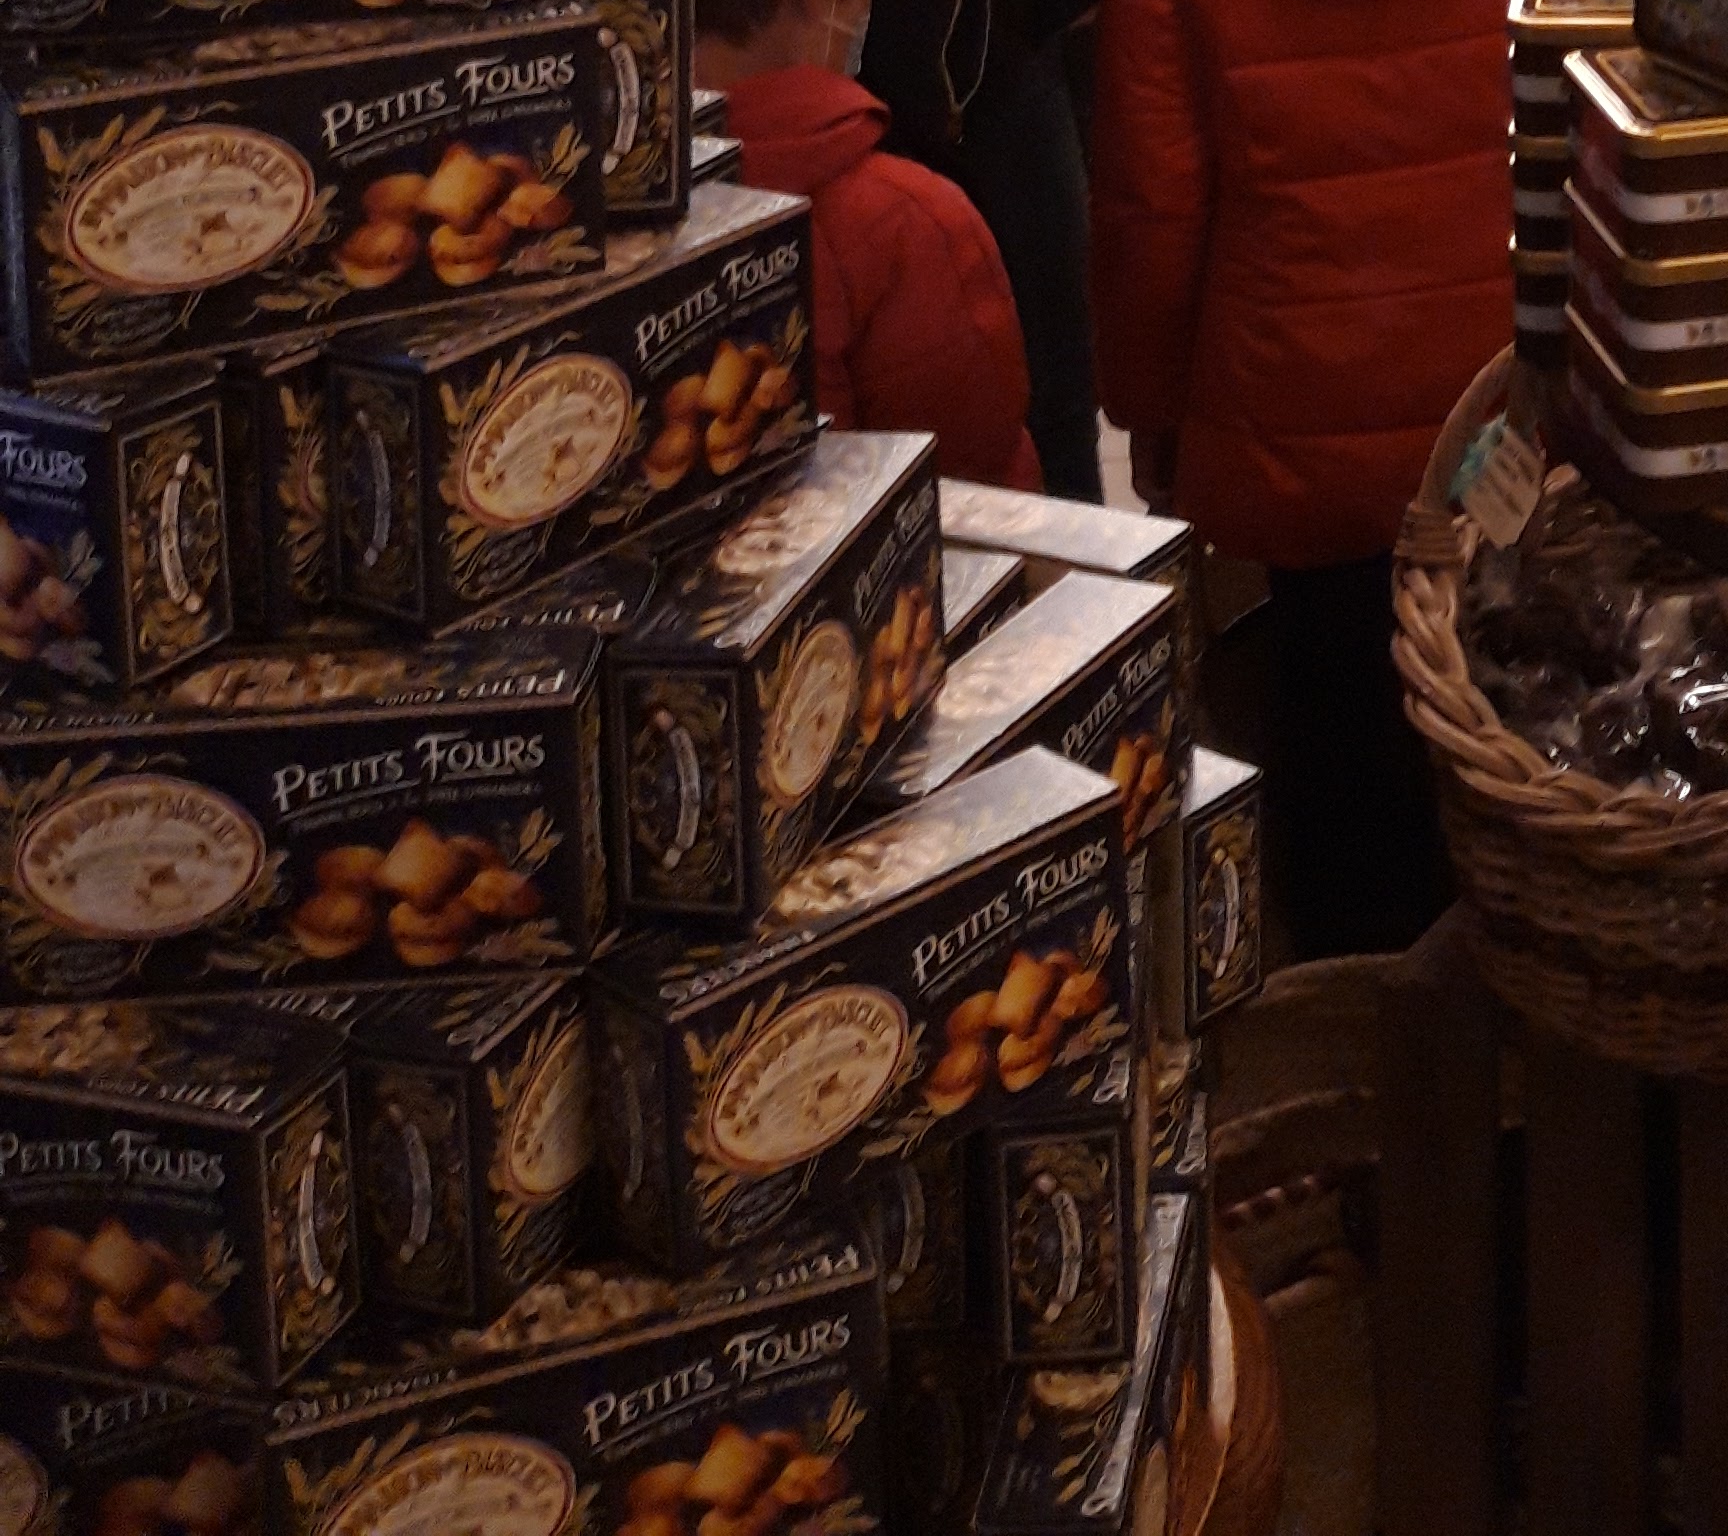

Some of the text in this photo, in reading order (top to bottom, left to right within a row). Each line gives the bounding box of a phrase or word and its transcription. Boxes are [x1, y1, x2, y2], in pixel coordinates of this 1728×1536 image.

[320, 77, 448, 151] PETITS
[454, 51, 576, 107] FOURS
[634, 282, 719, 363] PETITS
[721, 238, 801, 300] FOURS
[0, 428, 89, 490] FOURS
[272, 748, 406, 813] PETITS
[414, 728, 547, 784] FOURS
[911, 890, 1012, 988] PETITS
[1015, 837, 1109, 914] FOURS
[0, 1128, 226, 1189] PETITS FOURS
[583, 1357, 715, 1448] PETITS
[723, 1312, 851, 1382] FOURS
